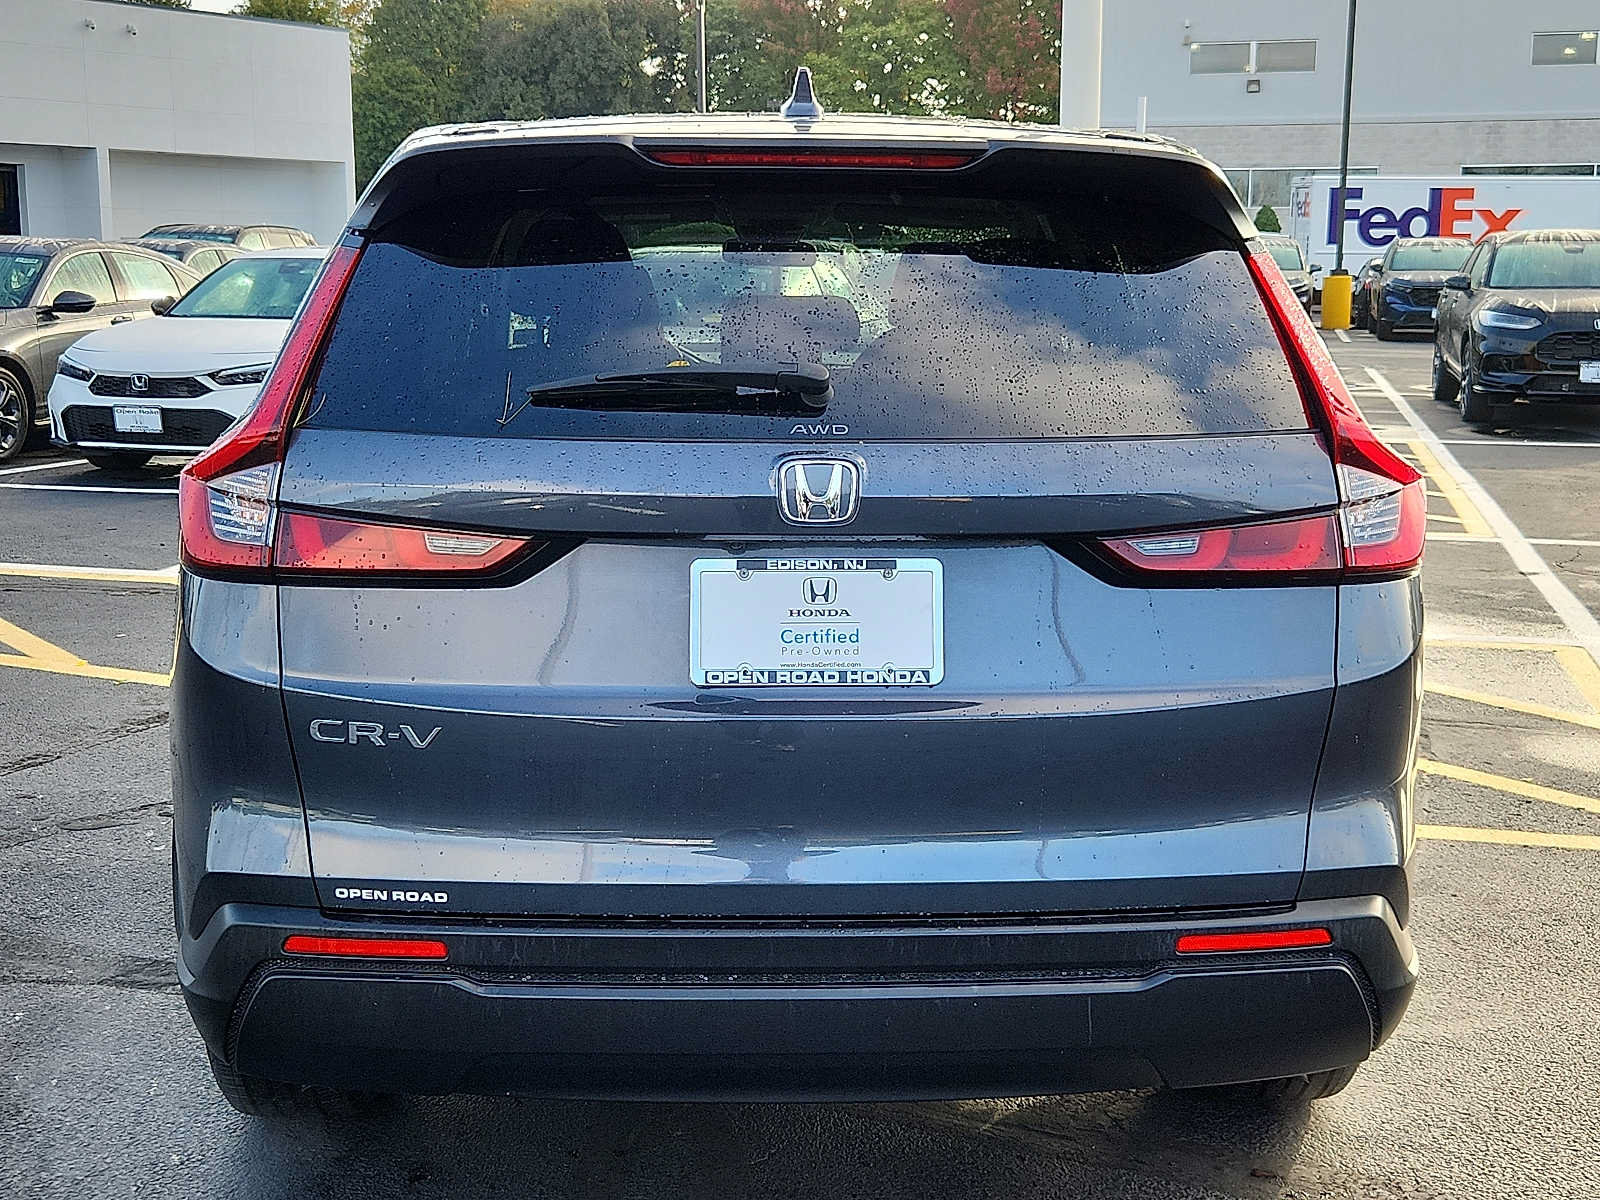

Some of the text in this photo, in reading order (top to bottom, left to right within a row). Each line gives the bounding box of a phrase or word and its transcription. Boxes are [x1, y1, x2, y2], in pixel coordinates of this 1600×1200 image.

[1327, 187, 1522, 246] FedEx
[790, 424, 849, 435] AWD
[766, 559, 868, 571] EDISON, NJ
[788, 608, 851, 617] HONDA
[780, 628, 860, 644] Certified
[781, 646, 860, 656] Pre-Owned
[706, 670, 930, 684] OPEN ROAD HONDA
[309, 718, 443, 750] CR-V
[334, 887, 449, 904] OPEN ROAD
